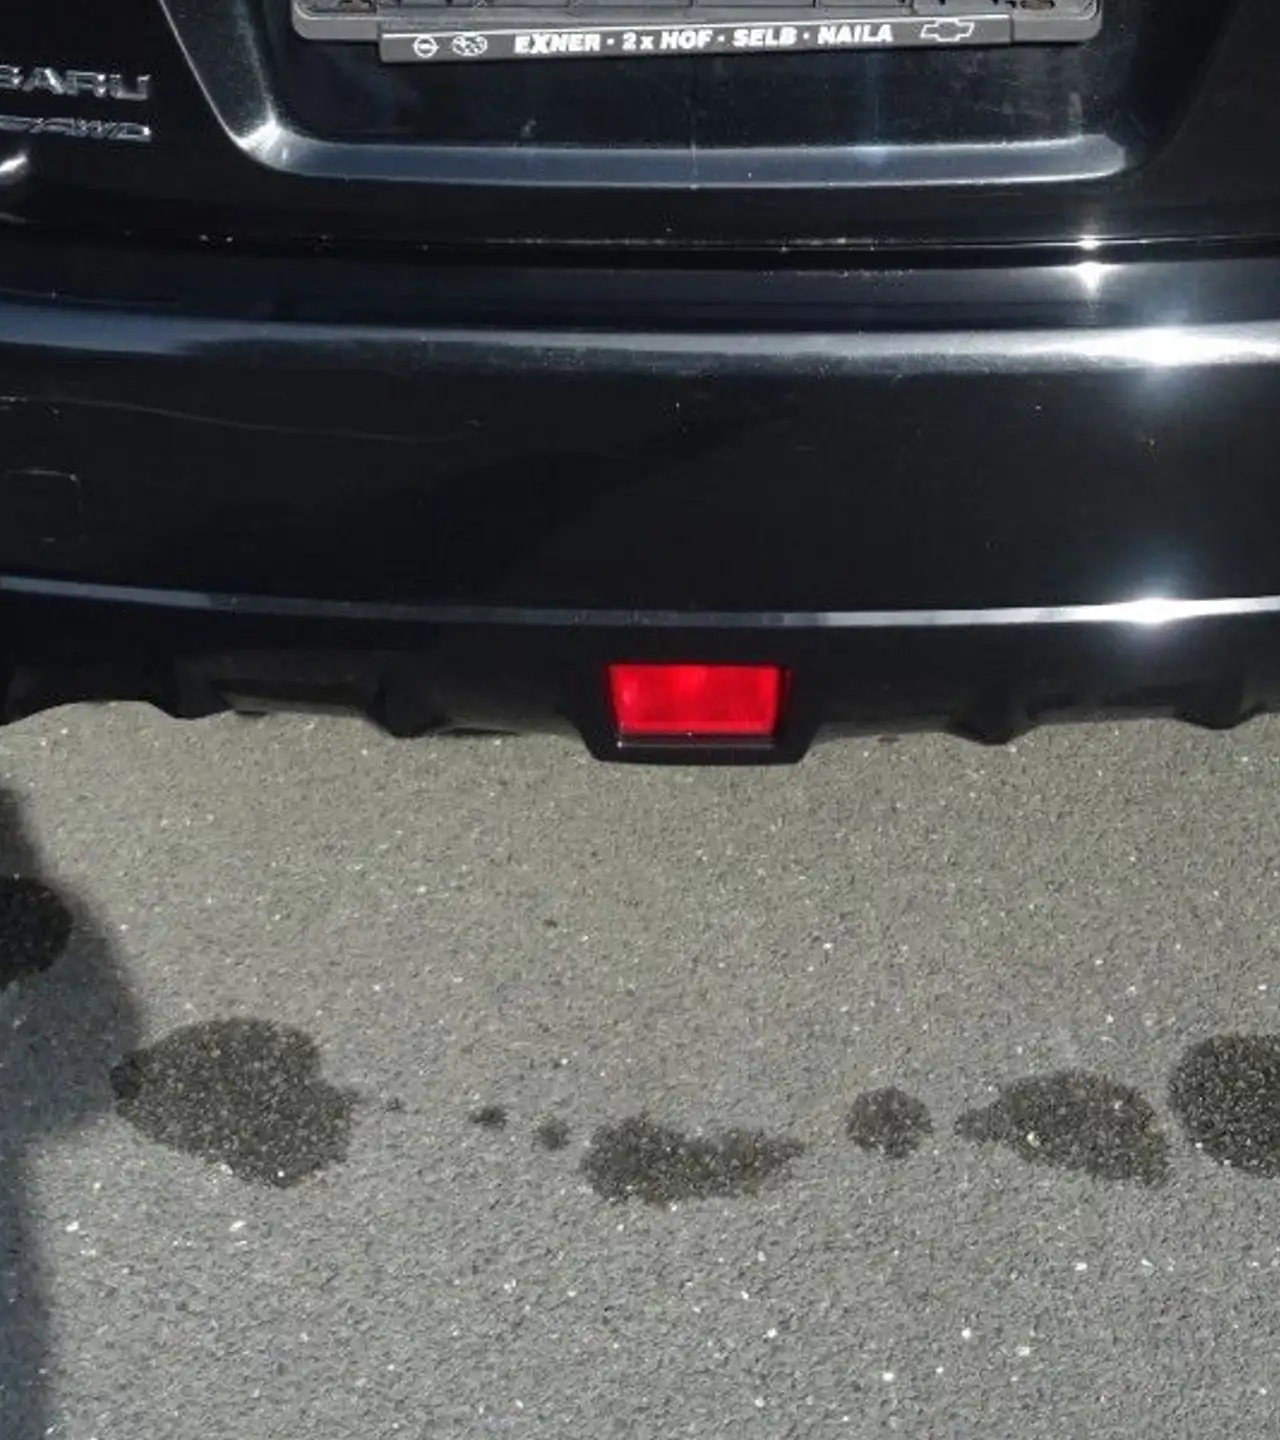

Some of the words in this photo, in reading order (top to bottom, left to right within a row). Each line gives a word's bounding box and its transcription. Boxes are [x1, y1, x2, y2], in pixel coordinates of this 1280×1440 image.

[514, 32, 601, 54] EXNER
[622, 31, 637, 51] 2
[640, 35, 655, 50] x
[659, 28, 714, 50] HOF
[732, 26, 798, 47] SELB
[817, 23, 894, 45] NAILA
